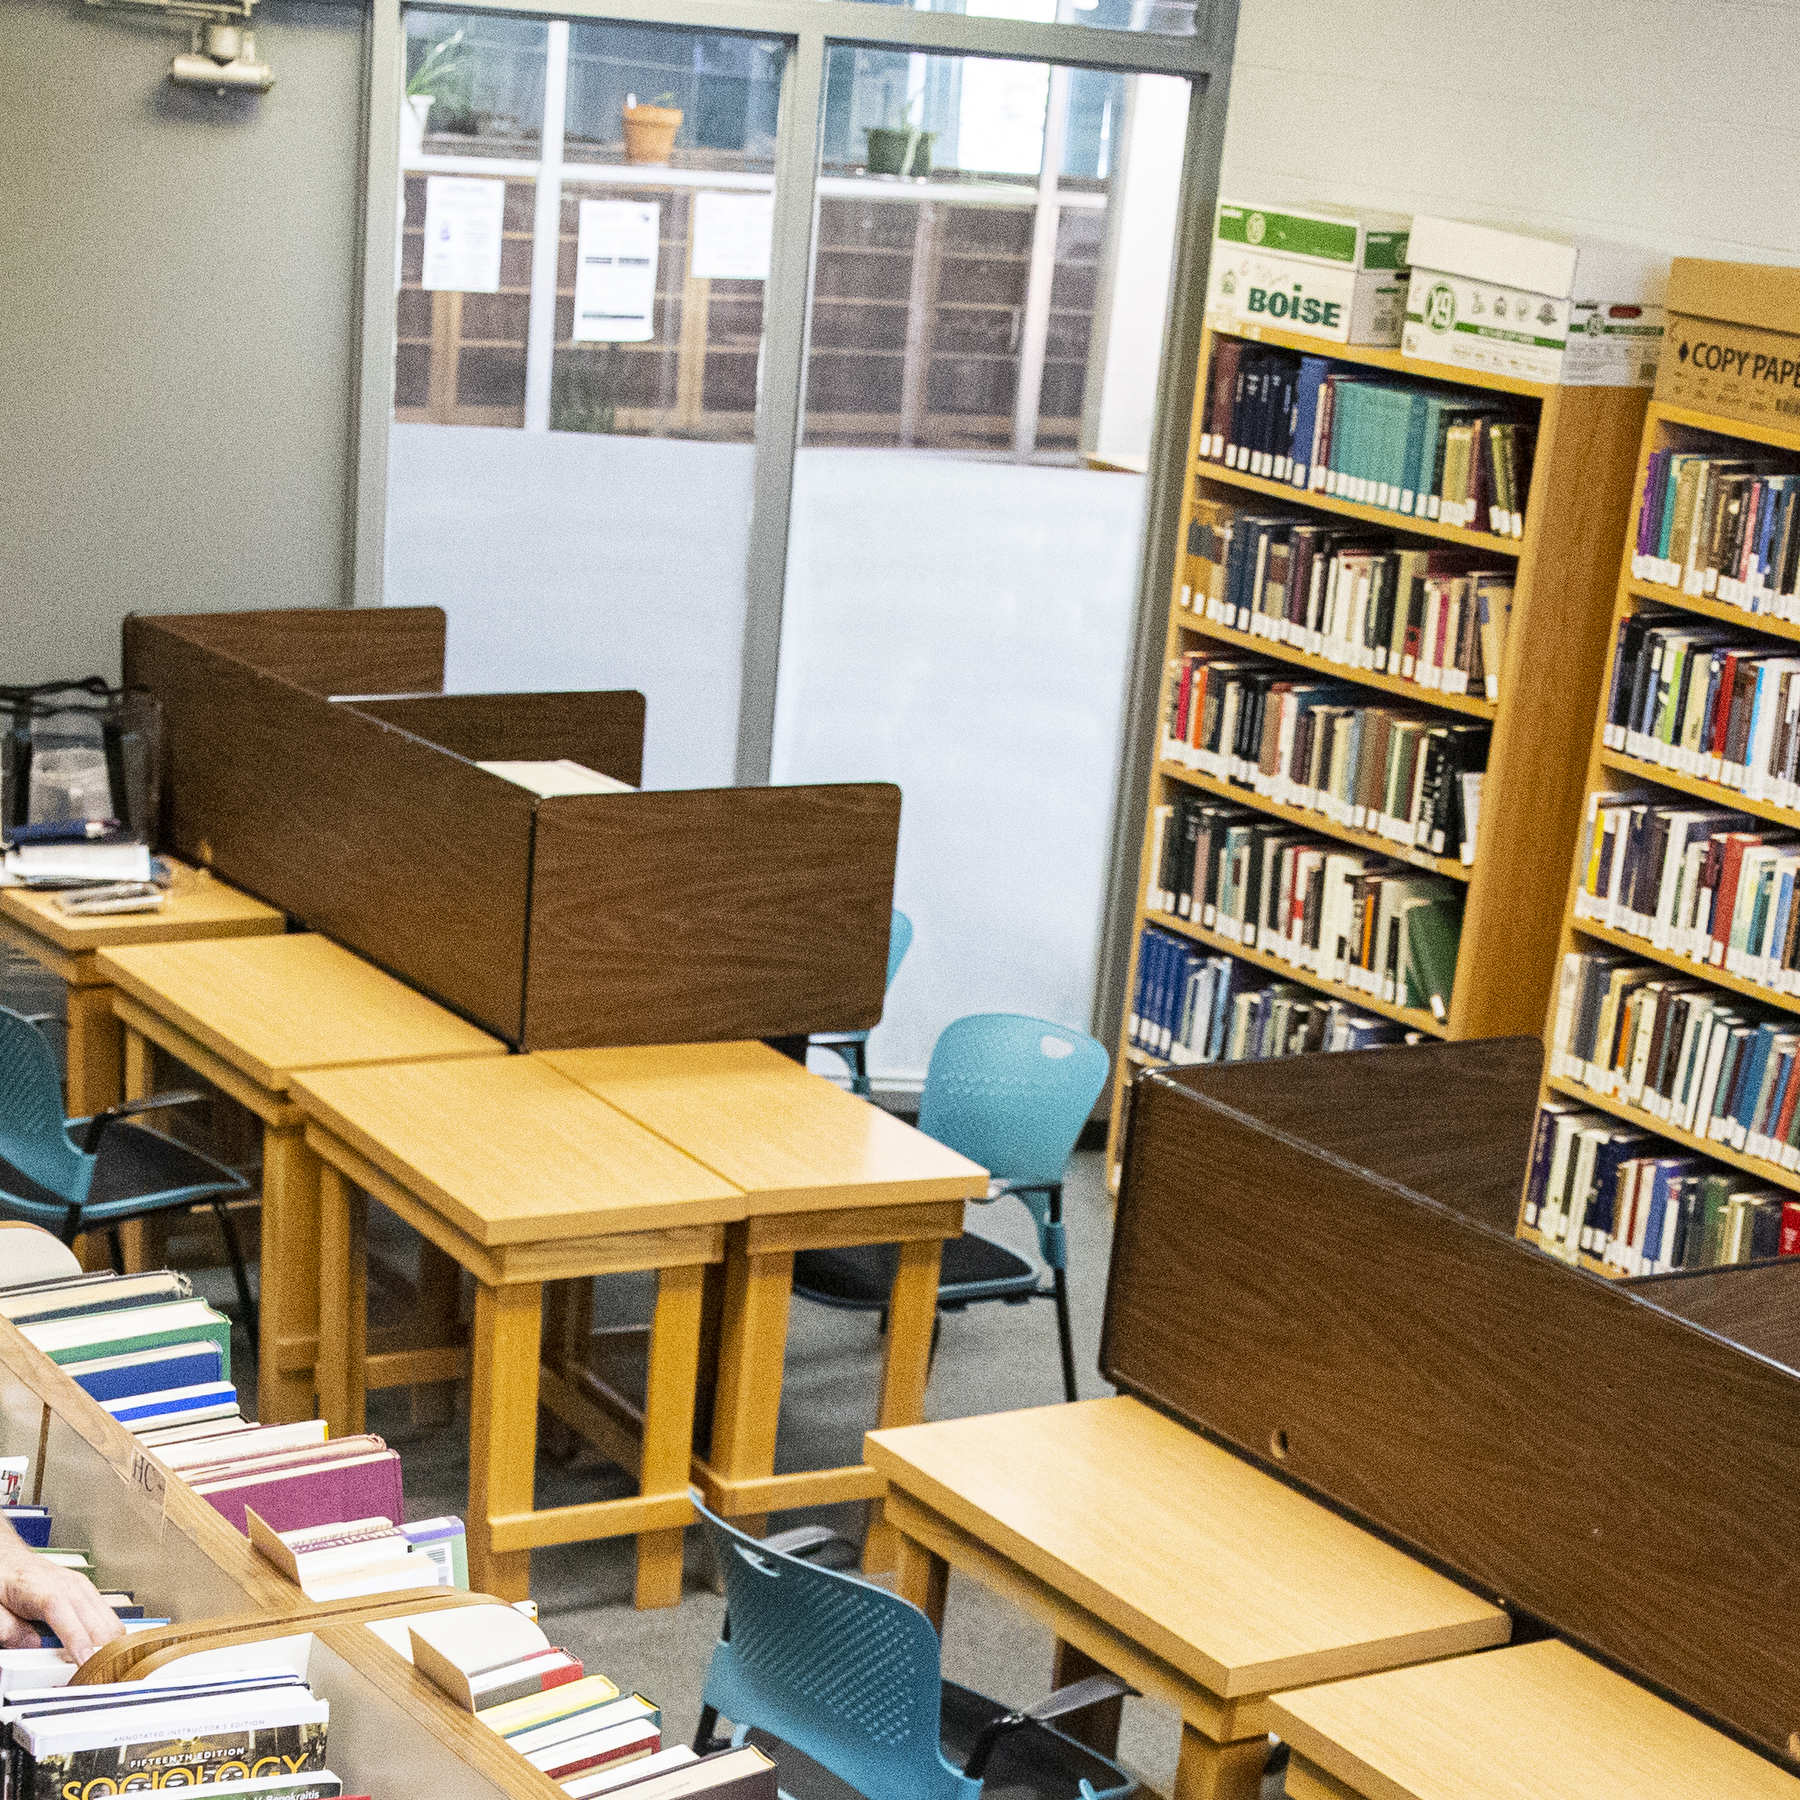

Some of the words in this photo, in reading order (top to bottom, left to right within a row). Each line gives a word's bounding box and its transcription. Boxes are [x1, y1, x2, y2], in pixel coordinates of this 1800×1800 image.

[1248, 284, 1341, 328] BOISE
[1692, 342, 1748, 377] COPY
[130, 1752, 196, 1768] FIFTEENTH
[200, 1747, 245, 1760] EDITION
